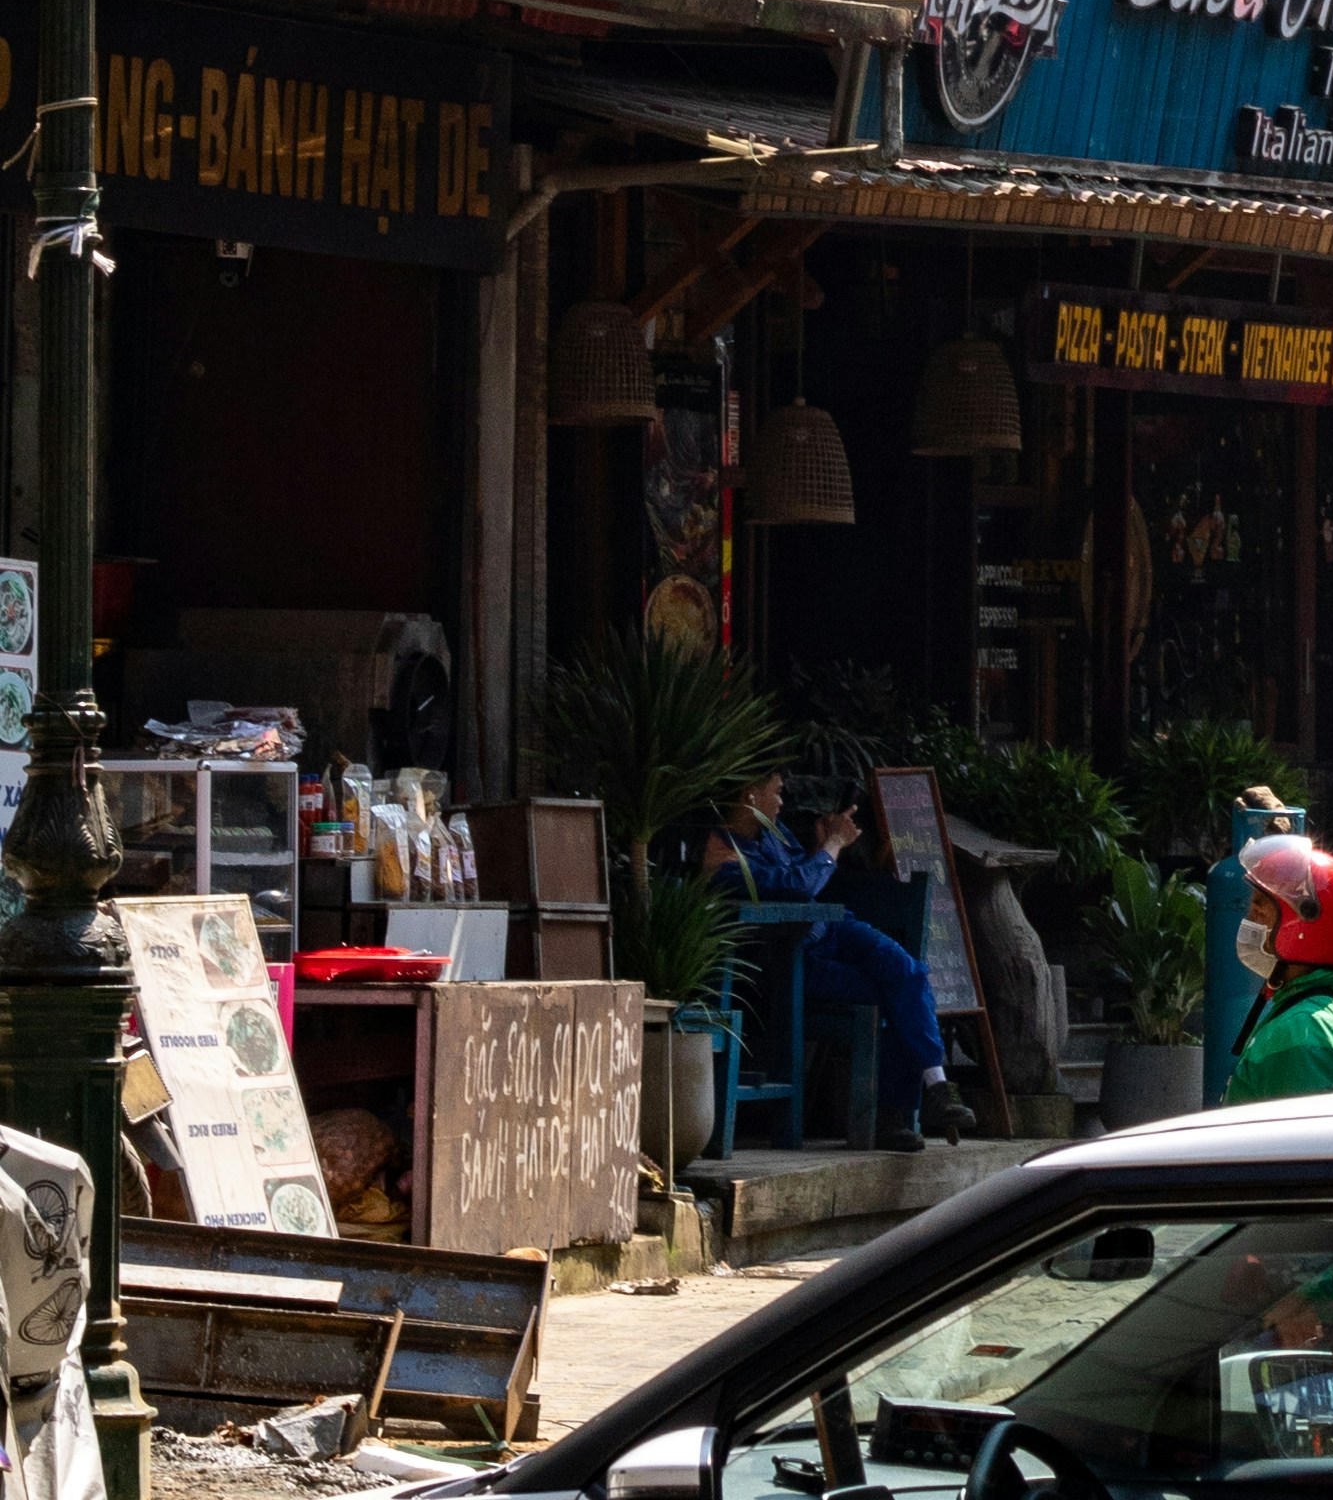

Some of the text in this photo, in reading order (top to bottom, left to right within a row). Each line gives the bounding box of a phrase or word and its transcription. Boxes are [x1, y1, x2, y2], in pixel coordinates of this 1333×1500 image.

[1251, 106, 1333, 166] Italian
[341, 88, 425, 235] HẠT
[1055, 302, 1101, 365] PIZZA
[1115, 309, 1167, 372] PASTA
[1179, 314, 1229, 376] STEAK
[159, 1034, 219, 1048] FRIED NOODLES
[187, 1122, 238, 1138] FRIED RICE
[226, 1211, 267, 1227] CHICKEN
